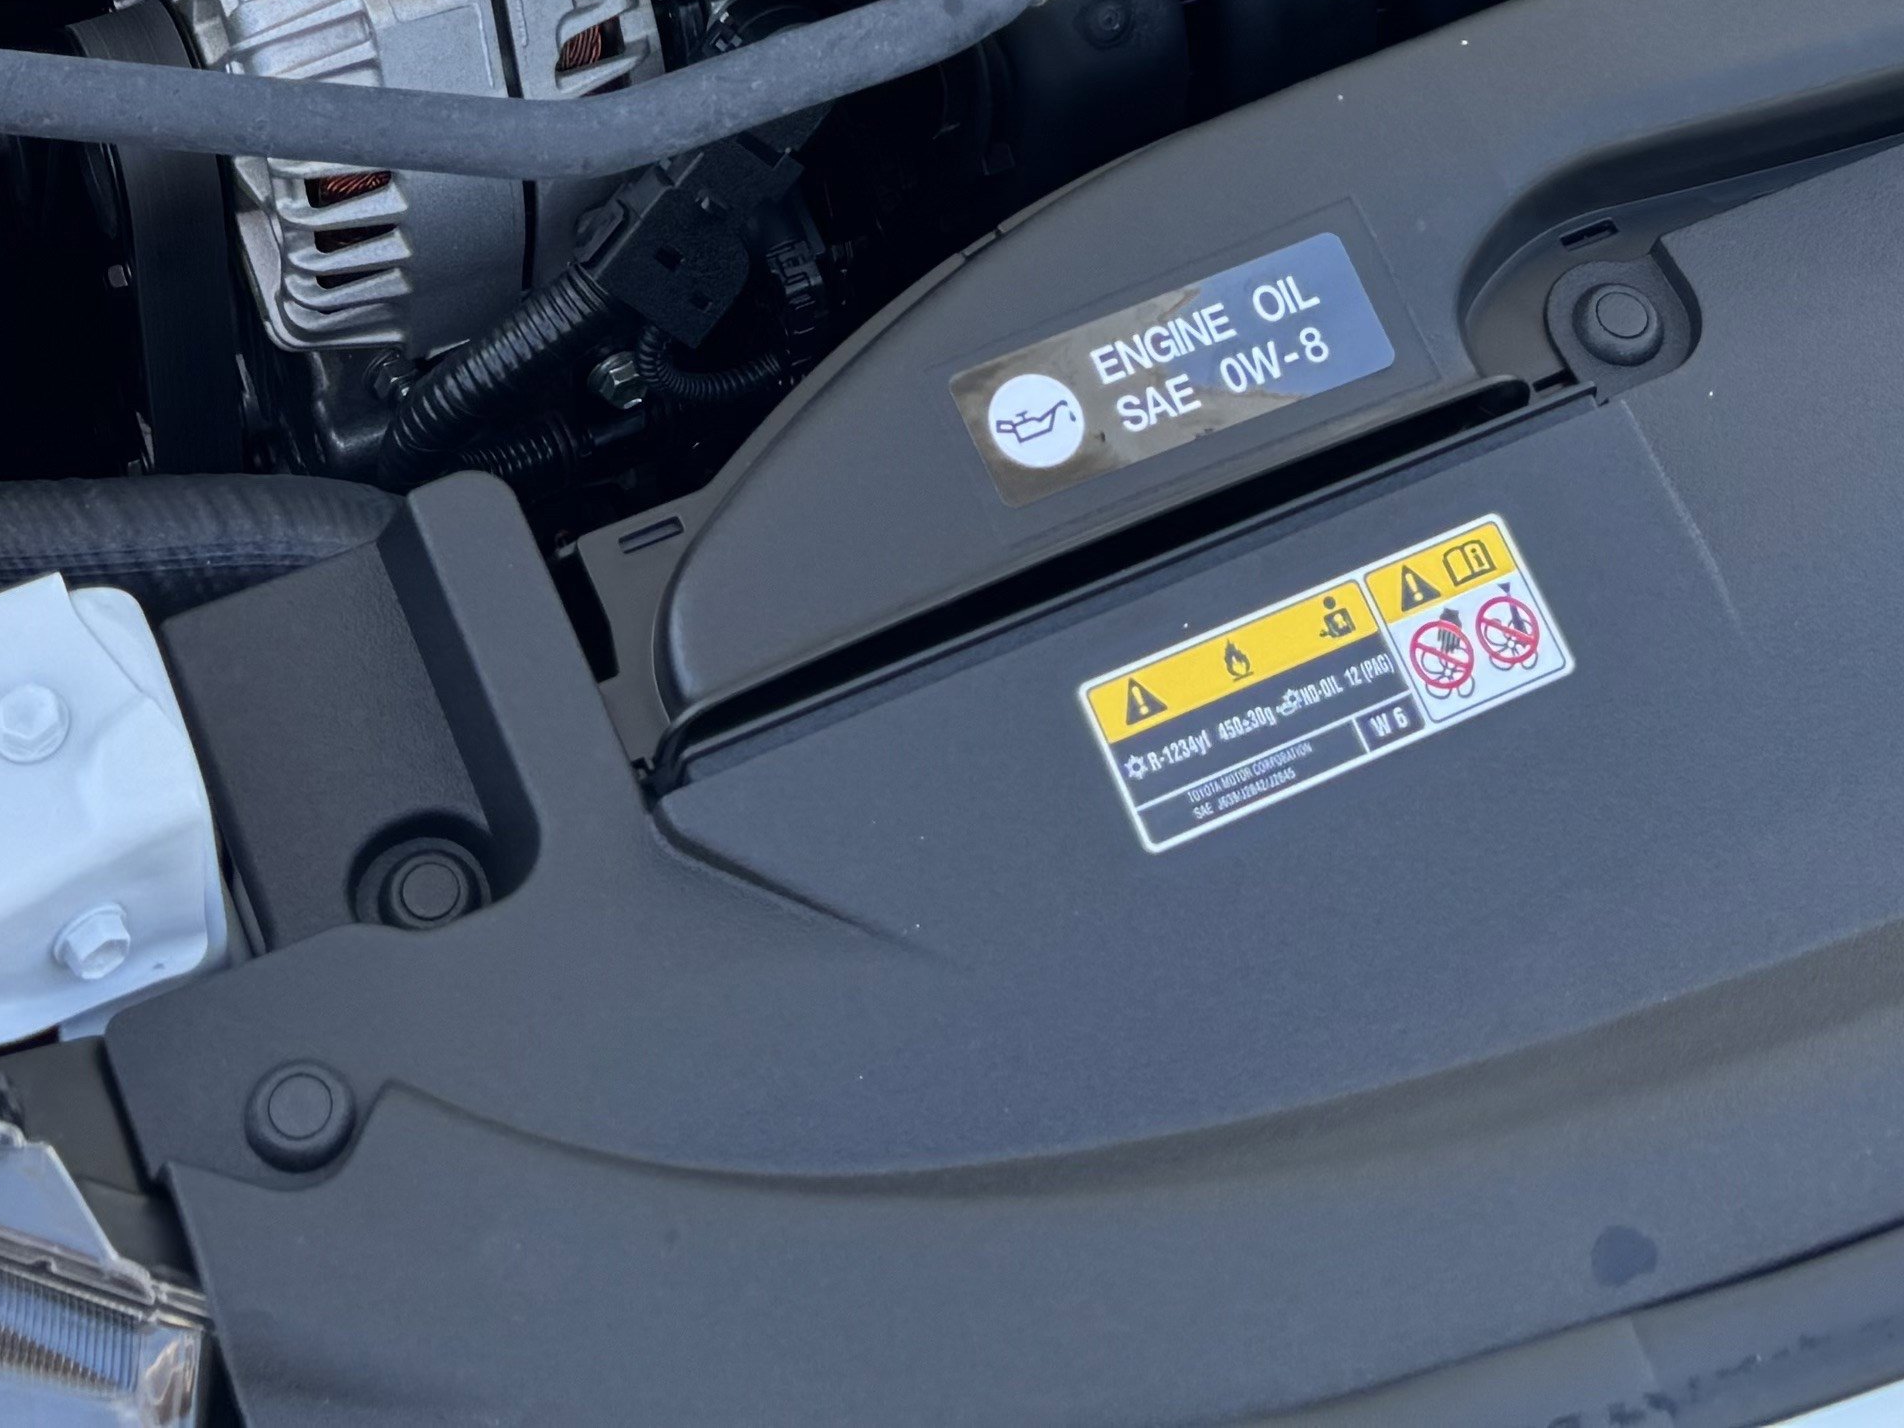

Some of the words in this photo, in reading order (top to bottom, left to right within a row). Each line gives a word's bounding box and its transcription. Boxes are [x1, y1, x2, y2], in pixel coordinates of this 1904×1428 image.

[1089, 301, 1238, 385] ENGINE
[1252, 274, 1321, 323] OIL
[1117, 373, 1203, 435] SAE
[1218, 326, 1330, 394] 0W-8
[1146, 729, 1213, 773] R-1234yf
[1217, 704, 1277, 742] 450±30g
[1299, 675, 1344, 706] ND-OIL
[1344, 667, 1363, 687] 12
[1362, 653, 1395, 685] (PAG)
[1370, 713, 1393, 739] W
[1393, 707, 1410, 729] 6
[1187, 781, 1222, 804] TOYOTA
[1221, 767, 1255, 790] MOTOR
